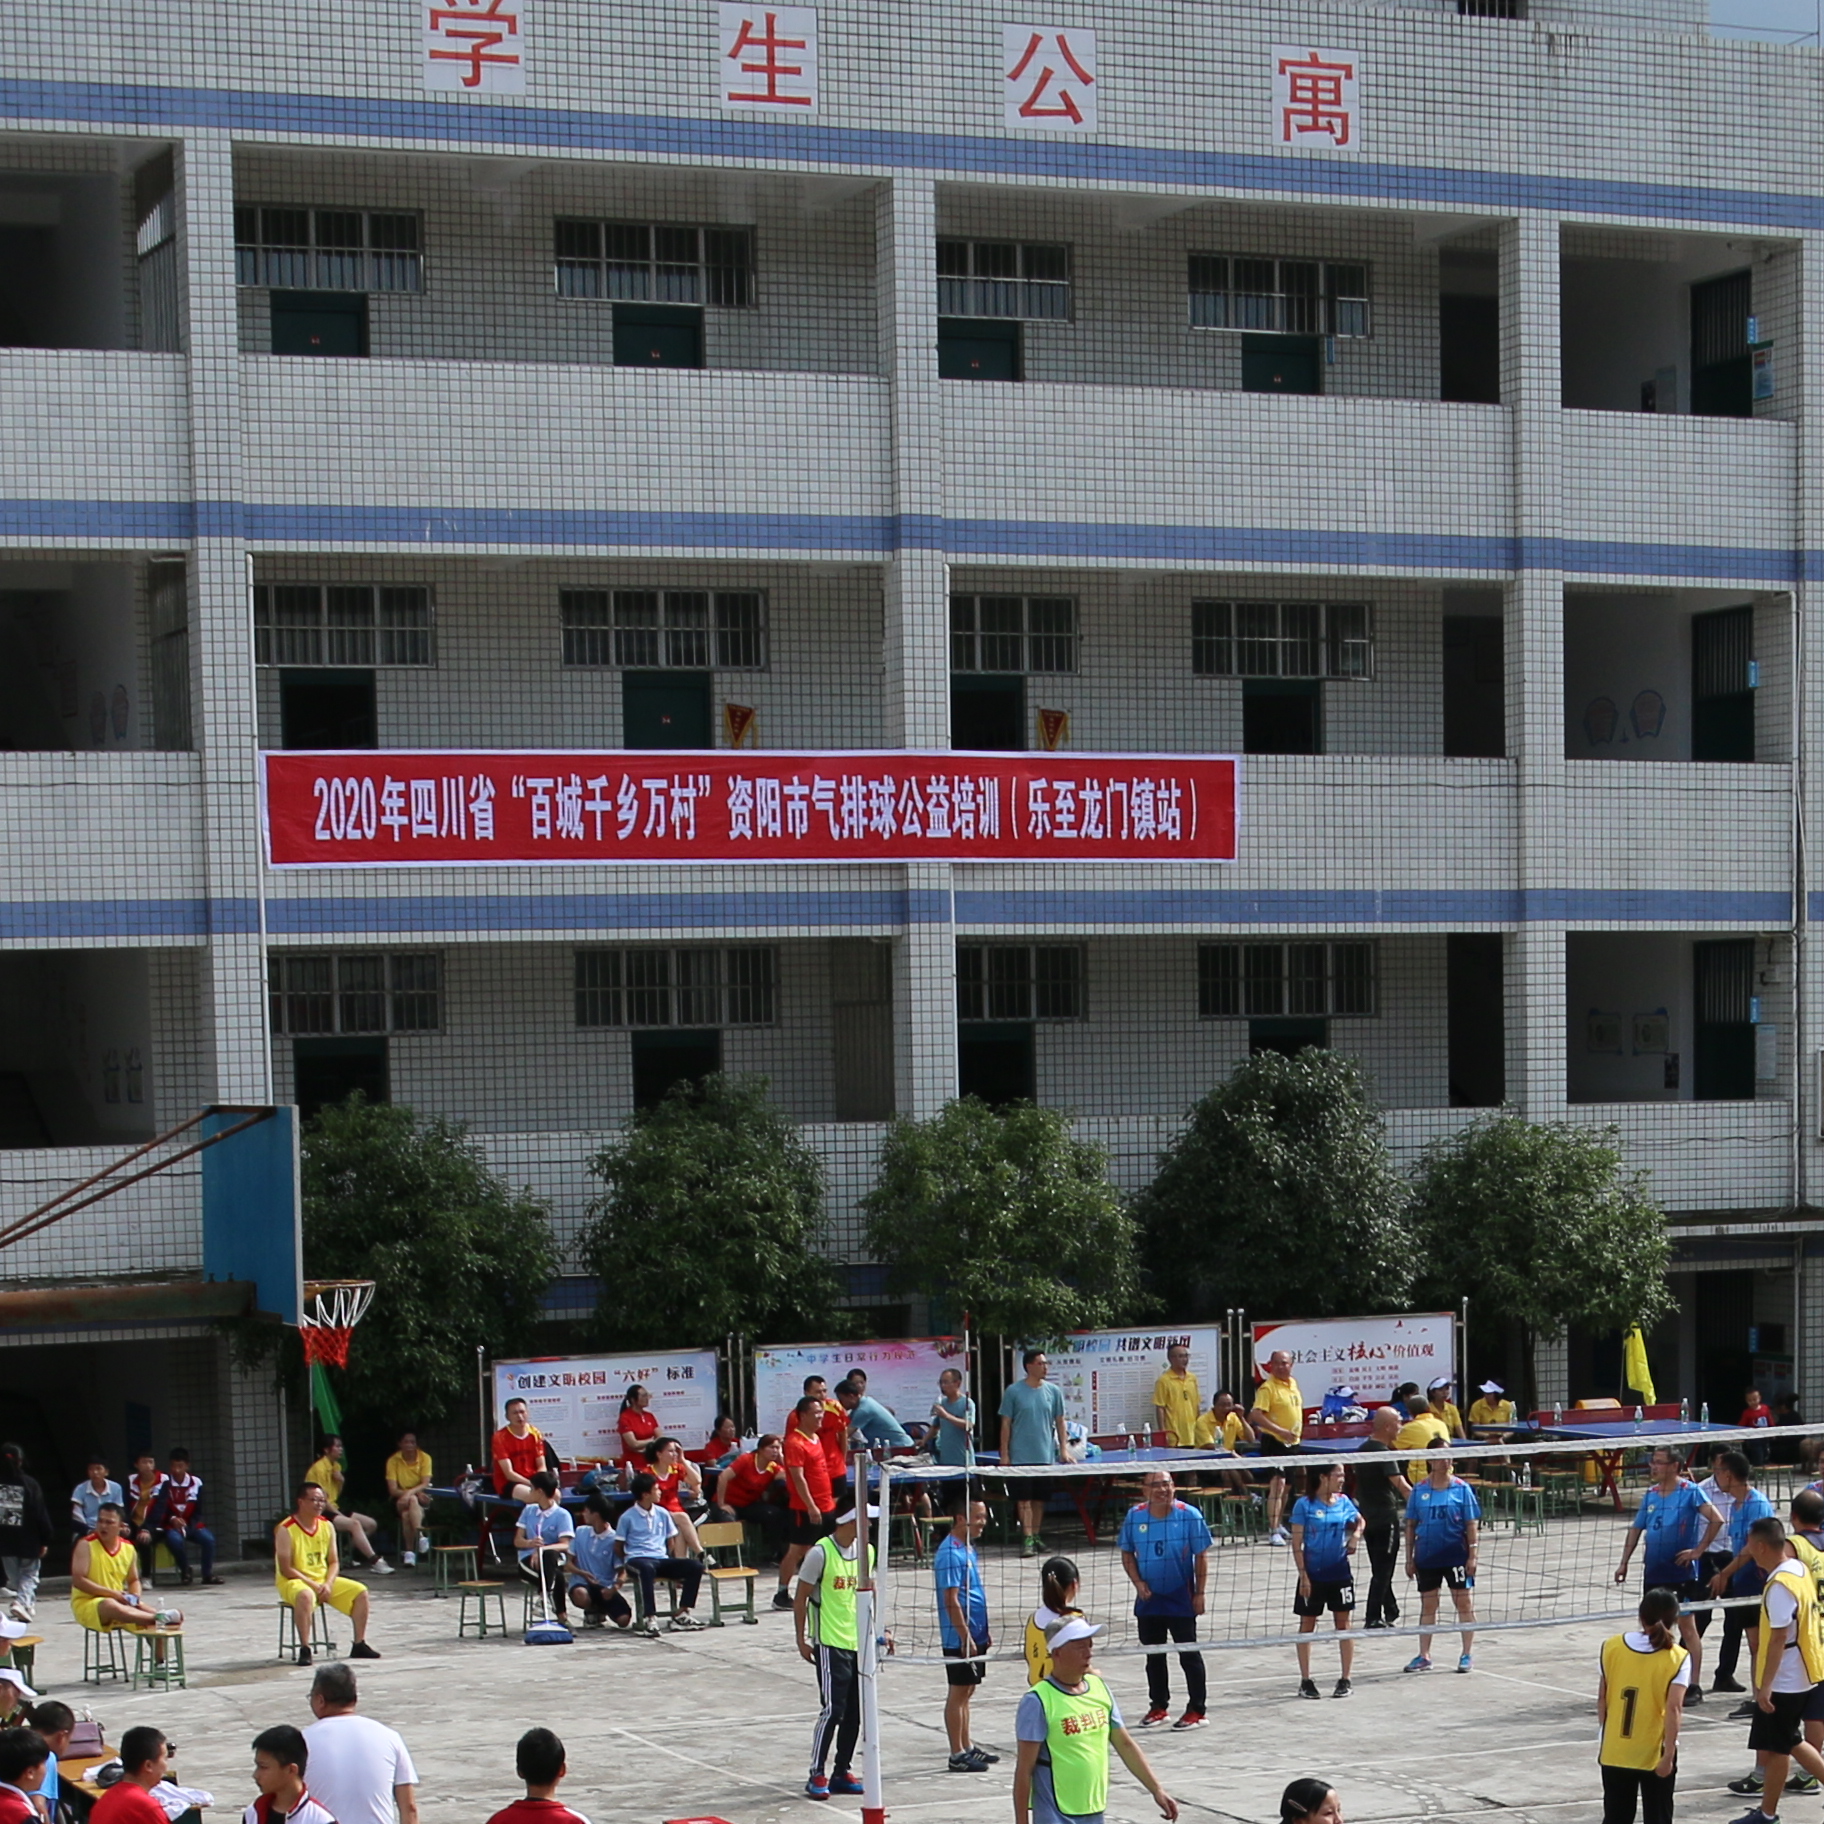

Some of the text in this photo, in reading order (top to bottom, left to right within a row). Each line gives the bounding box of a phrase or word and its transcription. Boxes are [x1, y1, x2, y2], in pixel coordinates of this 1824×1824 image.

[428, 0, 1353, 146] 学生公寓
[1154, 1540, 1165, 1557] 6
[1452, 1565, 1466, 1583] 13
[1339, 1586, 1354, 1605] 15
[1060, 1707, 1109, 1737] 裁判员
[1620, 1685, 1639, 1739] 1
